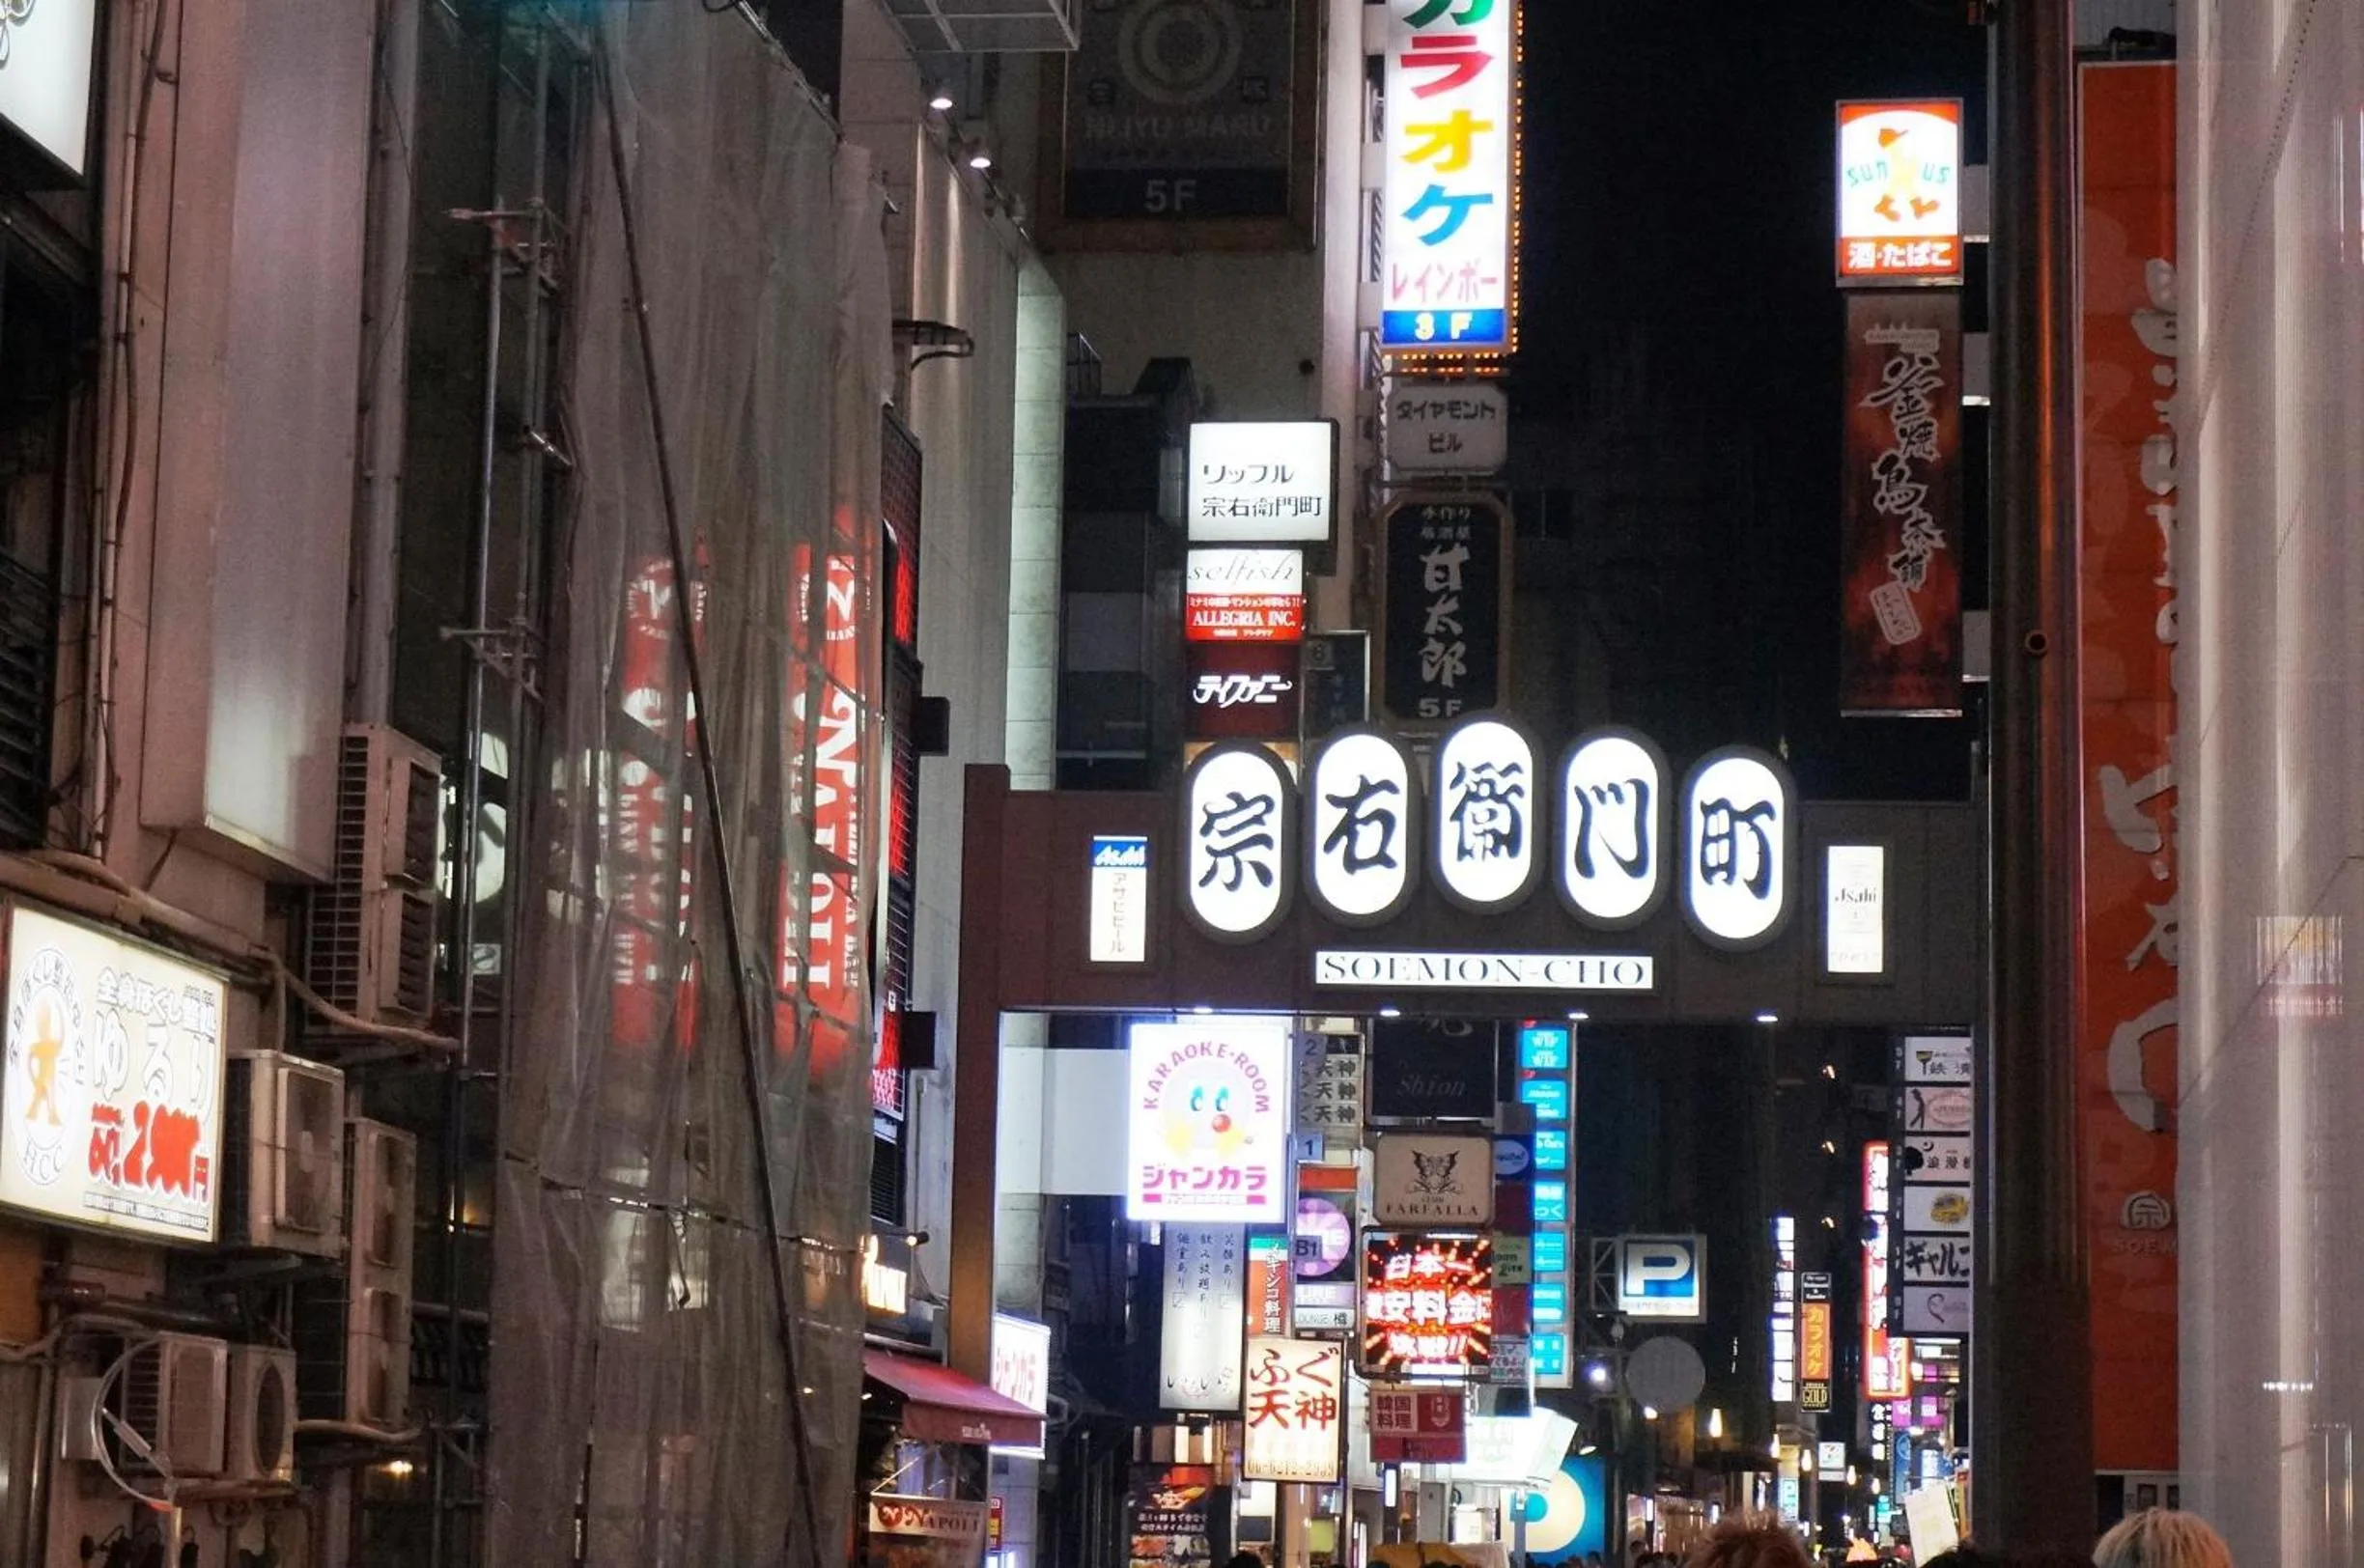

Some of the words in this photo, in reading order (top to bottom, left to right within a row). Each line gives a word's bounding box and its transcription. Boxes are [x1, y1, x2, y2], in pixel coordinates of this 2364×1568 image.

[1144, 180, 1196, 213] 5F
[1392, 258, 1498, 303] レインボー
[1201, 495, 1322, 518] 宗右衛門町
[1188, 553, 1295, 585] selfish
[1193, 610, 1264, 628] ALLEGRIA
[1268, 610, 1296, 628] INC.
[1419, 542, 1471, 688] 甘太郎
[1198, 760, 1777, 900] 宗右衛門町
[1324, 955, 1645, 986] SOEMON-CHO
[1305, 1041, 1317, 1054] 2
[1305, 1139, 1314, 1158] 1
[1142, 1163, 1267, 1191] ジャンカラ
[1387, 1205, 1479, 1218] FARFALLA
[1297, 1240, 1318, 1255] B1
[1626, 1243, 1690, 1296] P
[1808, 1305, 1825, 1377] カラオケ
[1250, 1347, 1339, 1388] ふぐ
[1248, 1388, 1337, 1431] 天神
[1376, 1395, 1412, 1412] 韓国
[1376, 1413, 1412, 1429] 料理
[904, 1506, 978, 1532] NAPOLI
